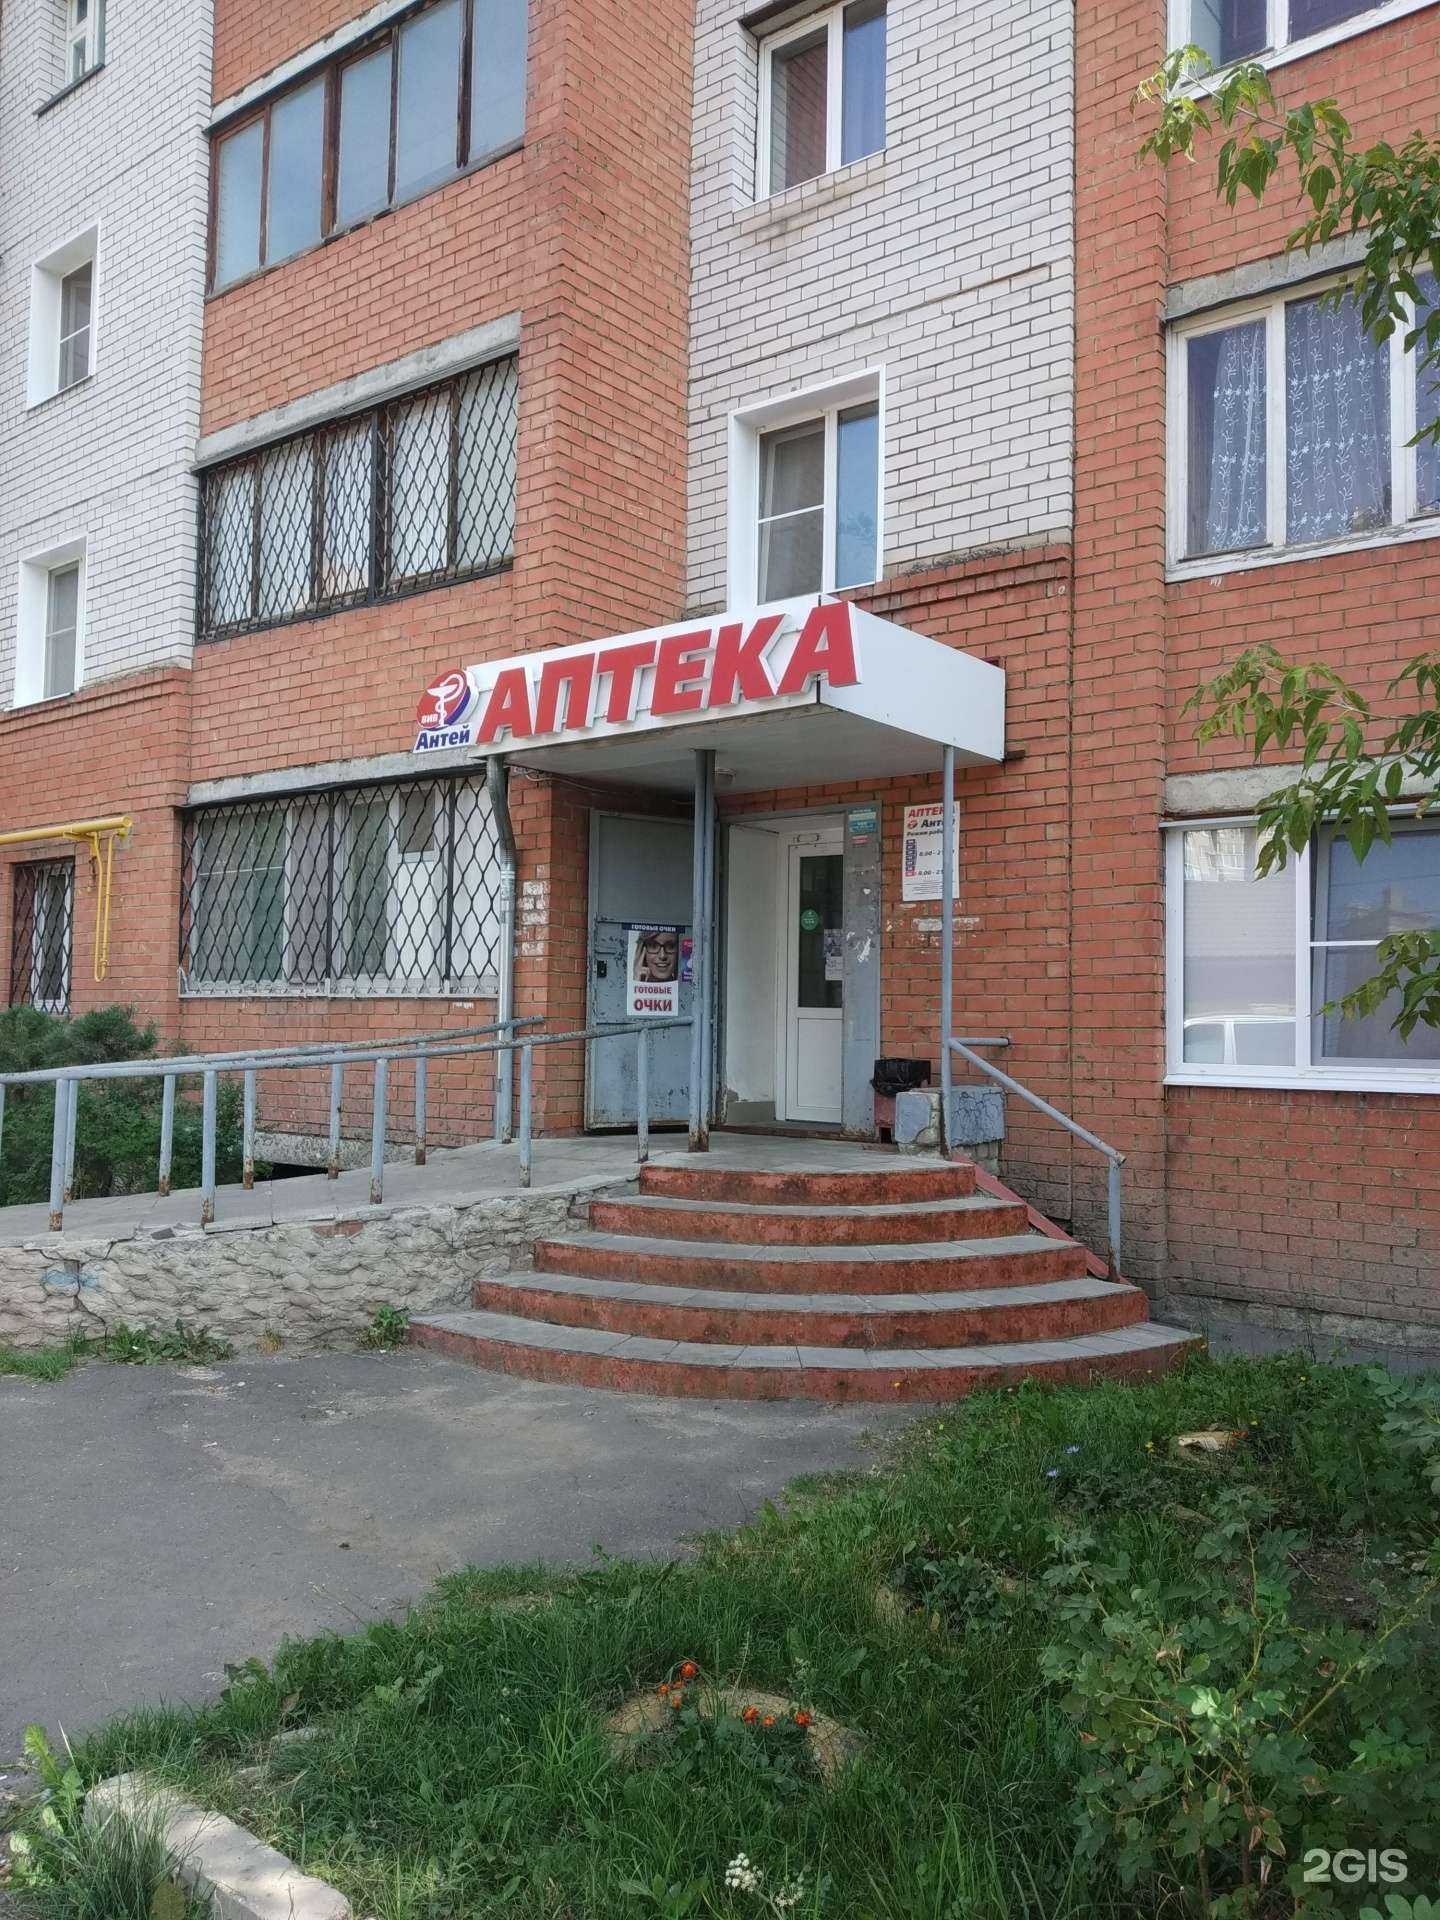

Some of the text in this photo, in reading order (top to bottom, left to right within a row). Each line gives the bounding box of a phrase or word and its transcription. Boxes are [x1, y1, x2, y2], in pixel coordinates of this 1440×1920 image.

[476, 601, 859, 744] АПТЕКА
[416, 724, 470, 750] Антей
[908, 805, 955, 817] АПТЕ
[634, 986, 672, 995] ГОТОВЫЕ
[634, 999, 672, 1011] ОЧКИ
